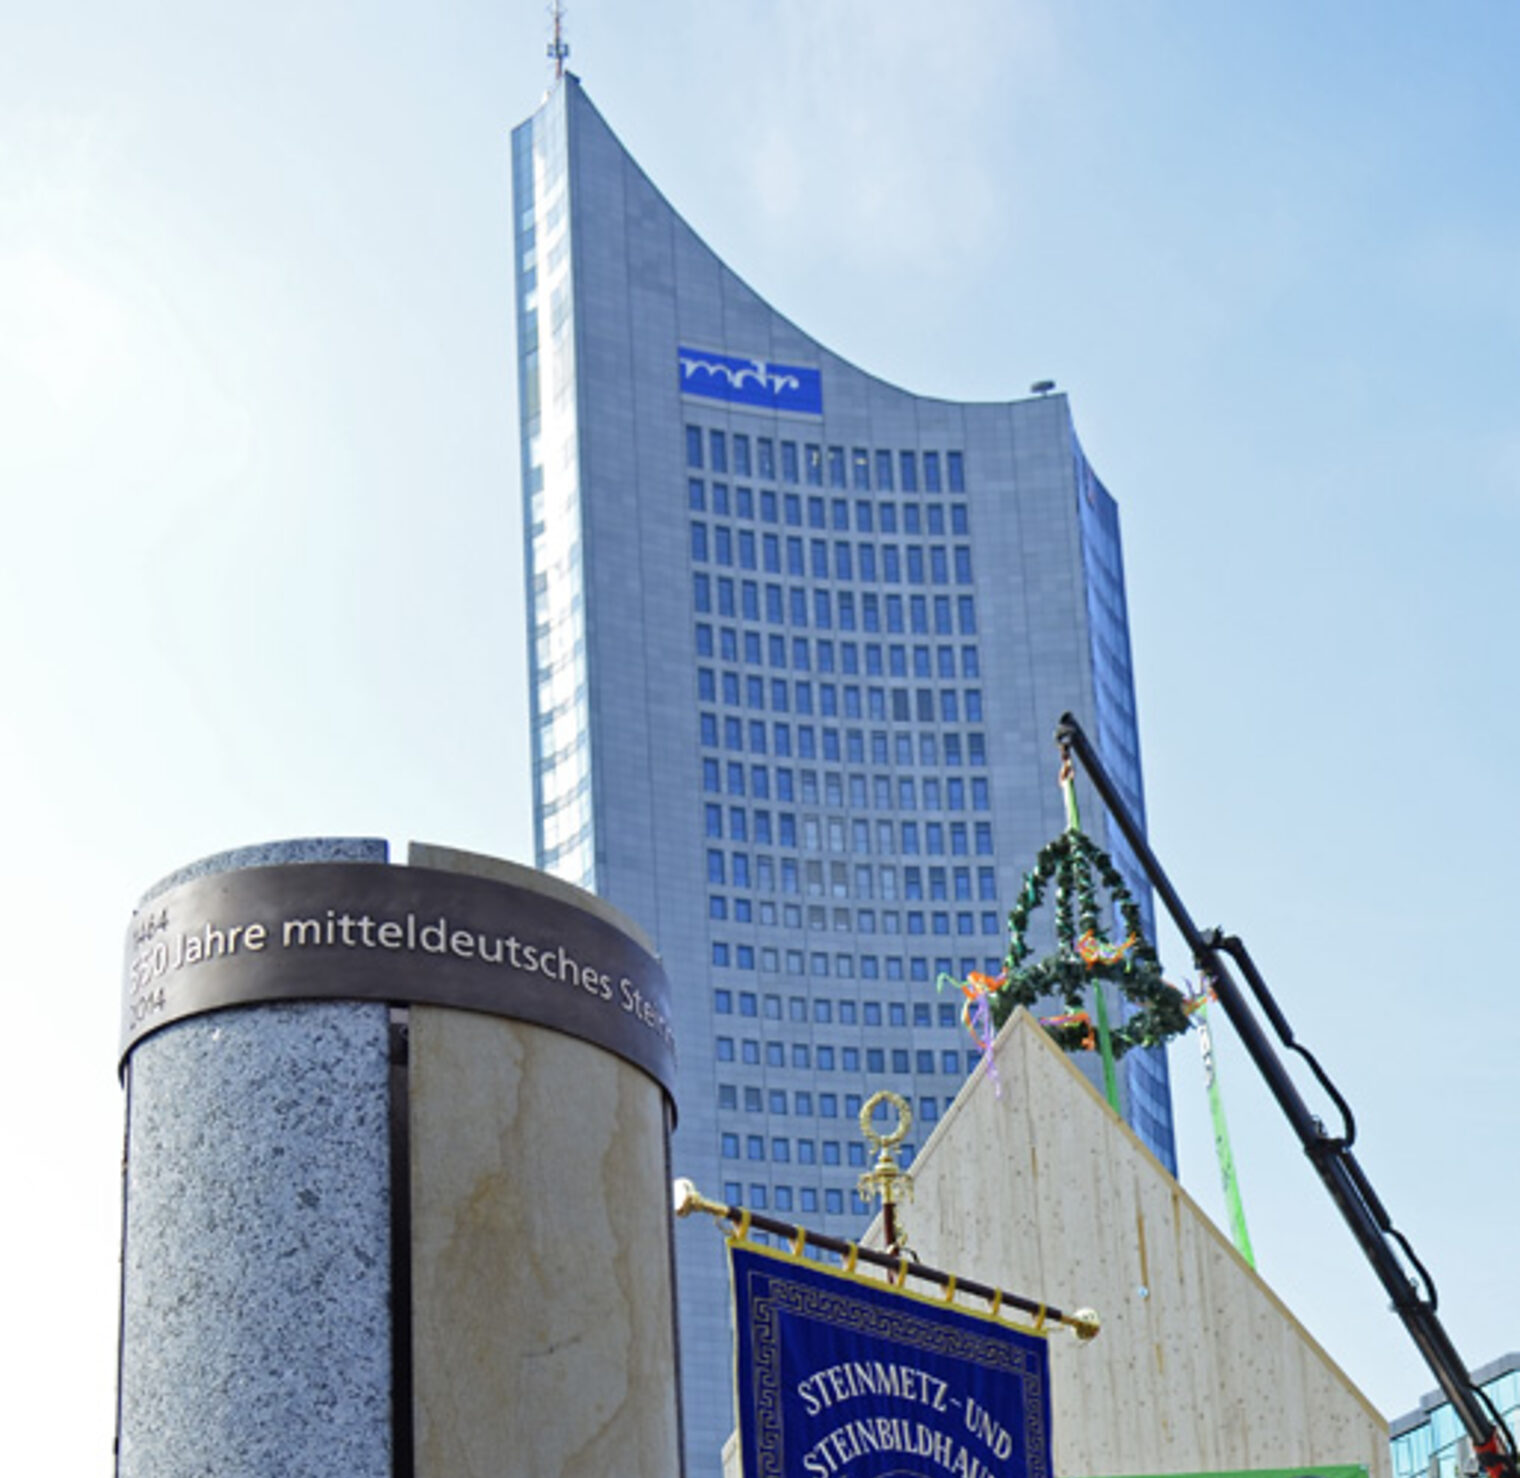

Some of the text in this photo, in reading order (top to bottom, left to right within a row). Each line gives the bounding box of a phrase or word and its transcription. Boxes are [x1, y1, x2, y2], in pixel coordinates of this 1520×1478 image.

[679, 359, 800, 395] mdr
[174, 921, 267, 970] Jahre
[282, 910, 613, 1000] mitteldeutsches
